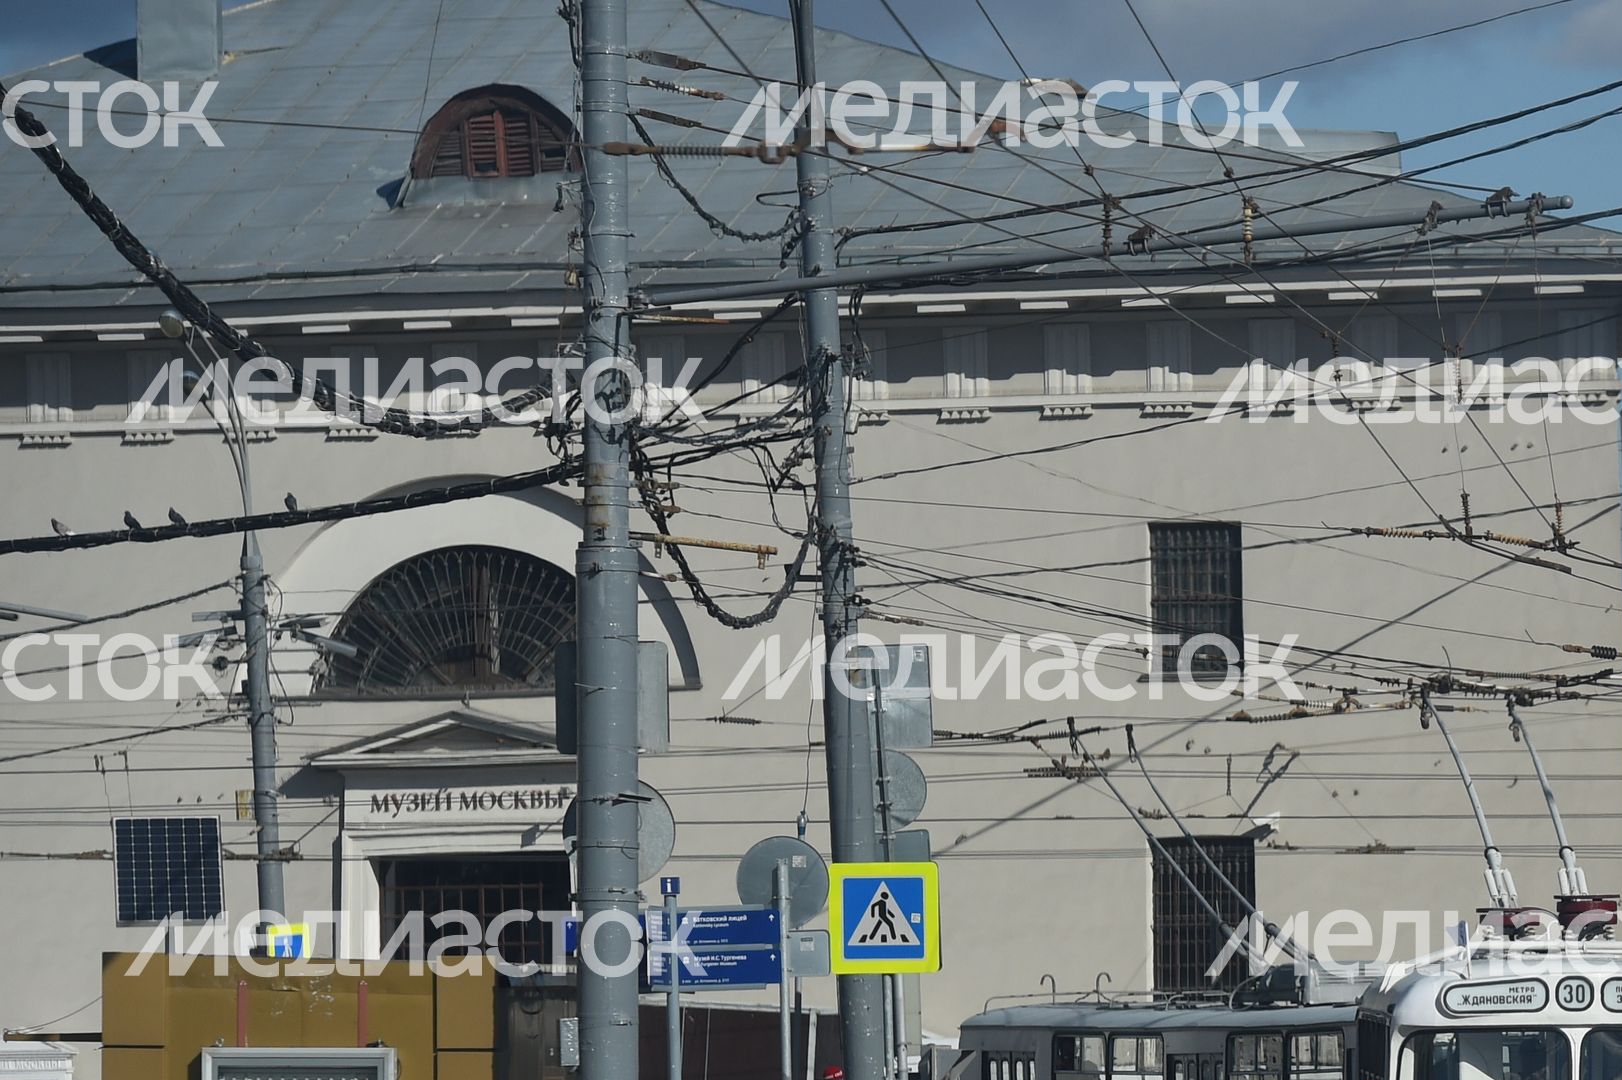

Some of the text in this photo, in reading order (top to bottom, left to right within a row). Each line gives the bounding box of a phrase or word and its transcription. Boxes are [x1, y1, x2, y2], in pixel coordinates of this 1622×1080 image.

[370, 788, 566, 818] МУЗЕЙ МОСКВЫ
[1508, 985, 1536, 995] МЕТРО
[1563, 984, 1586, 1004] 30
